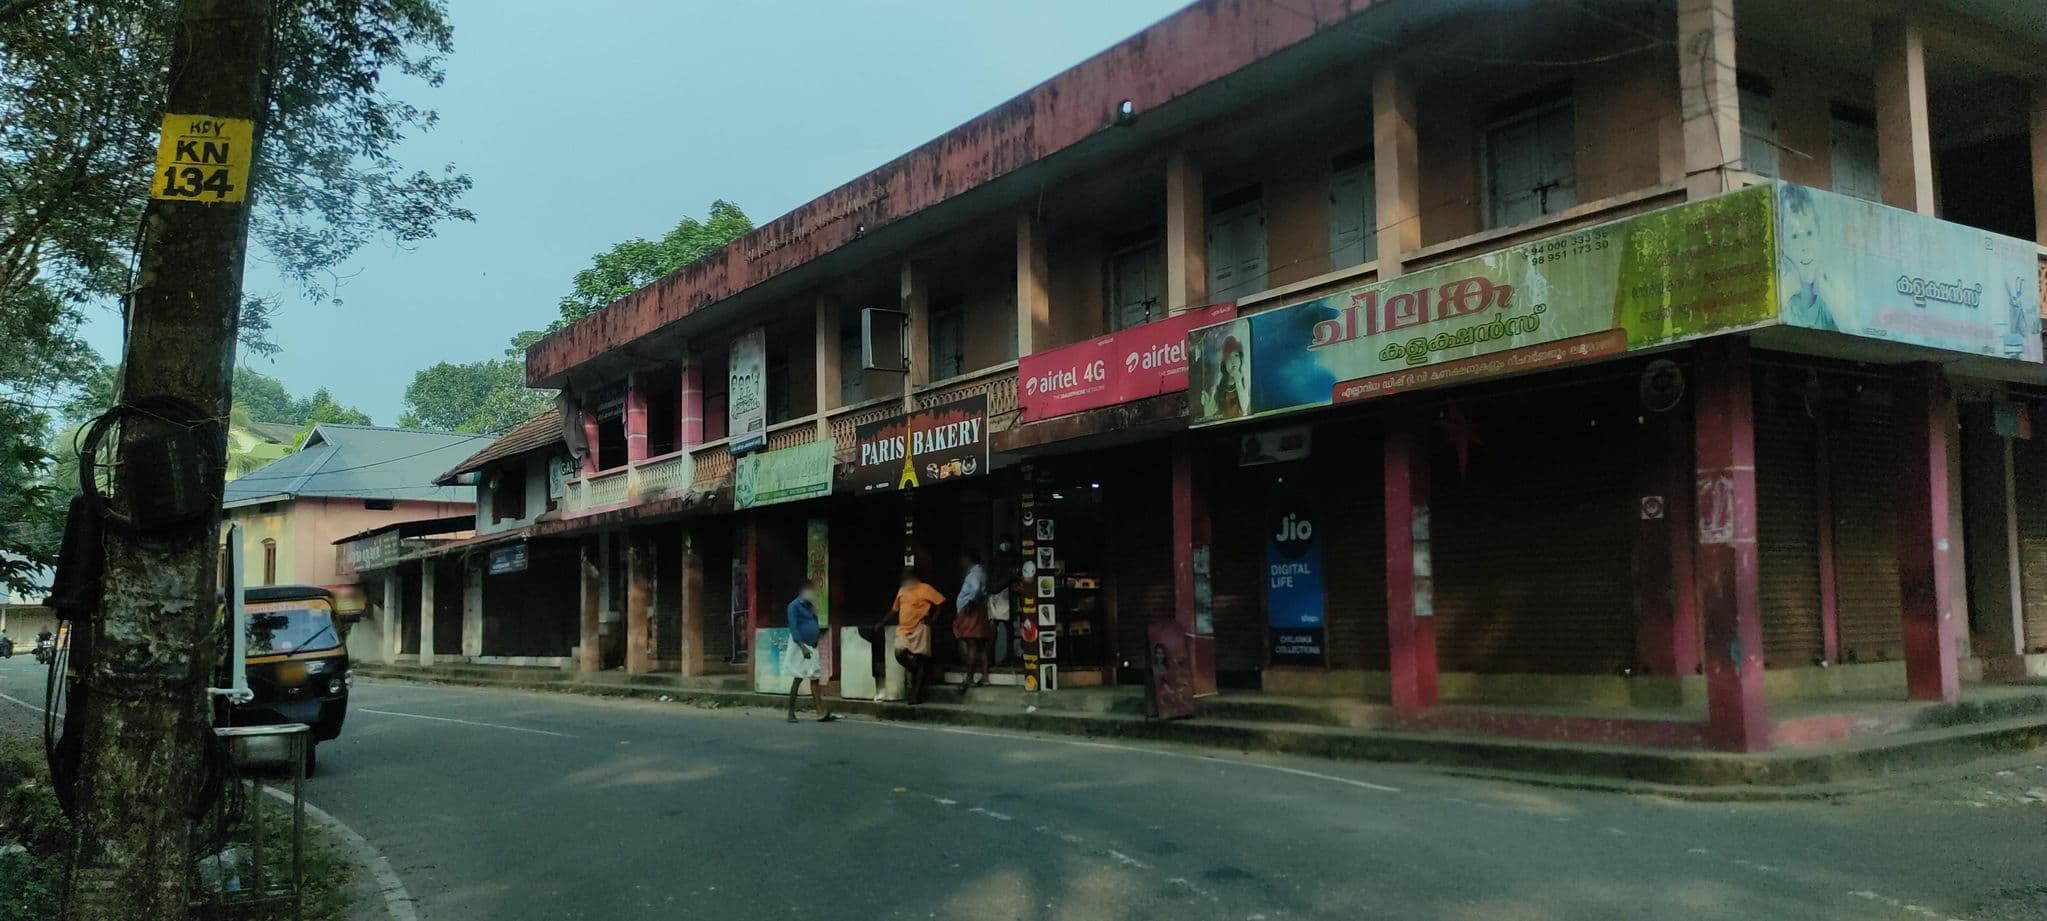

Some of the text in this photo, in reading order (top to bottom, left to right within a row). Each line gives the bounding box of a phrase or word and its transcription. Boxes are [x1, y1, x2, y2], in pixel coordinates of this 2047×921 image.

[176, 140, 229, 164] KN
[163, 166, 234, 198] 134
[1531, 246, 1544, 256] 94
[1547, 240, 1567, 252] 000
[1571, 233, 1591, 246] 333
[1531, 239, 1609, 266] 98 951 173 30
[1142, 339, 1187, 370] airtel
[1039, 360, 1105, 393] airtel 4G
[861, 417, 981, 466] PARIS BAKERY
[1276, 512, 1312, 541] Jio
[1271, 563, 1311, 576] DIGITAL
[1271, 576, 1294, 589] LIFE
